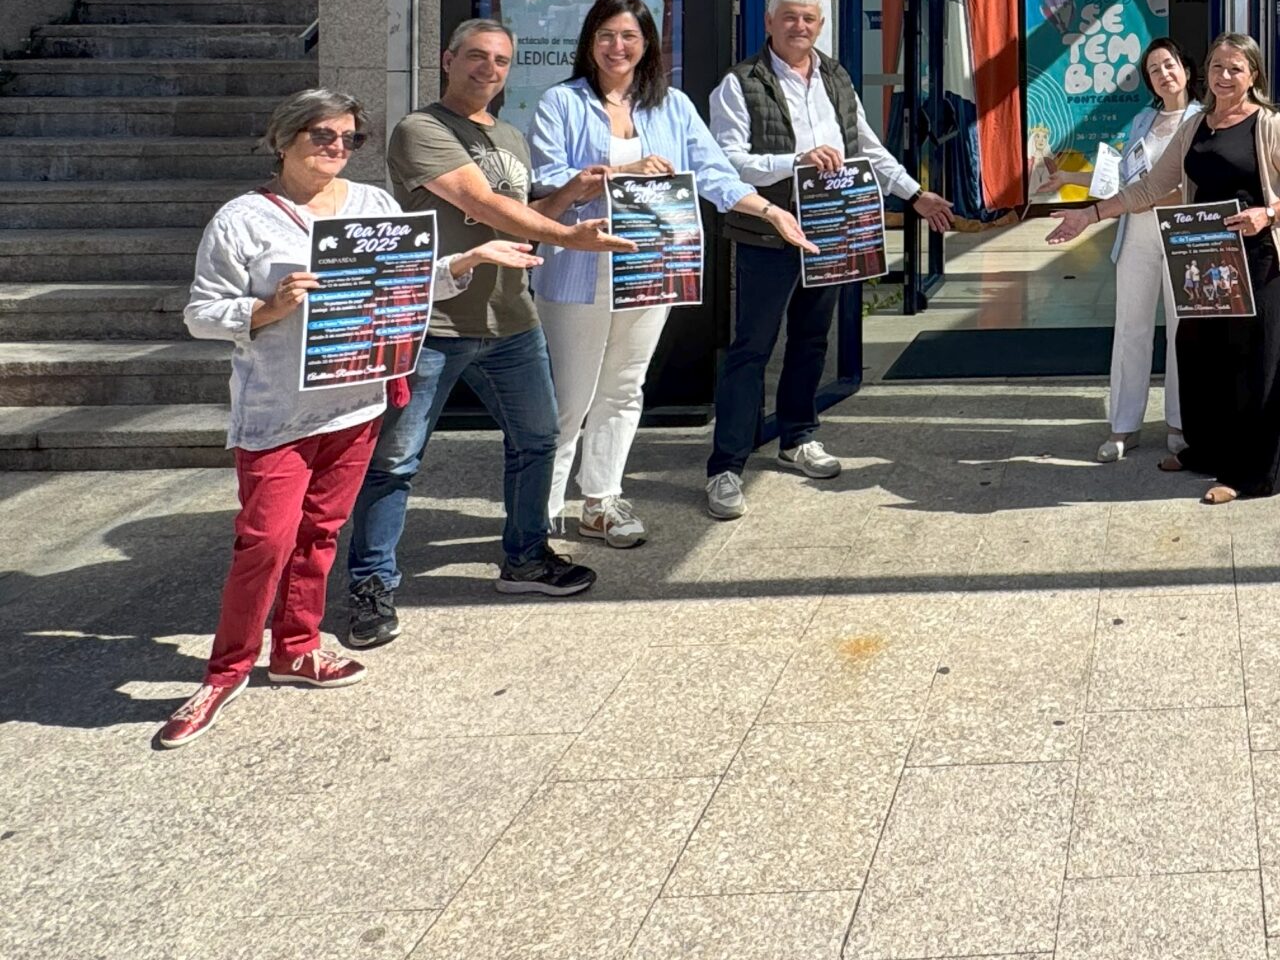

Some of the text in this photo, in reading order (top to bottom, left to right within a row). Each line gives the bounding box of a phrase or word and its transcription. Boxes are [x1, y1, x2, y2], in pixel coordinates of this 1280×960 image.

[1062, 33, 1141, 63] TEM
[516, 50, 577, 66] LEDICIAS
[1065, 63, 1140, 94] BRO
[824, 176, 855, 190] 2025
[1173, 210, 1221, 223] Tea Trea
[344, 222, 412, 239] Tea Trea
[352, 237, 401, 254] 2025
